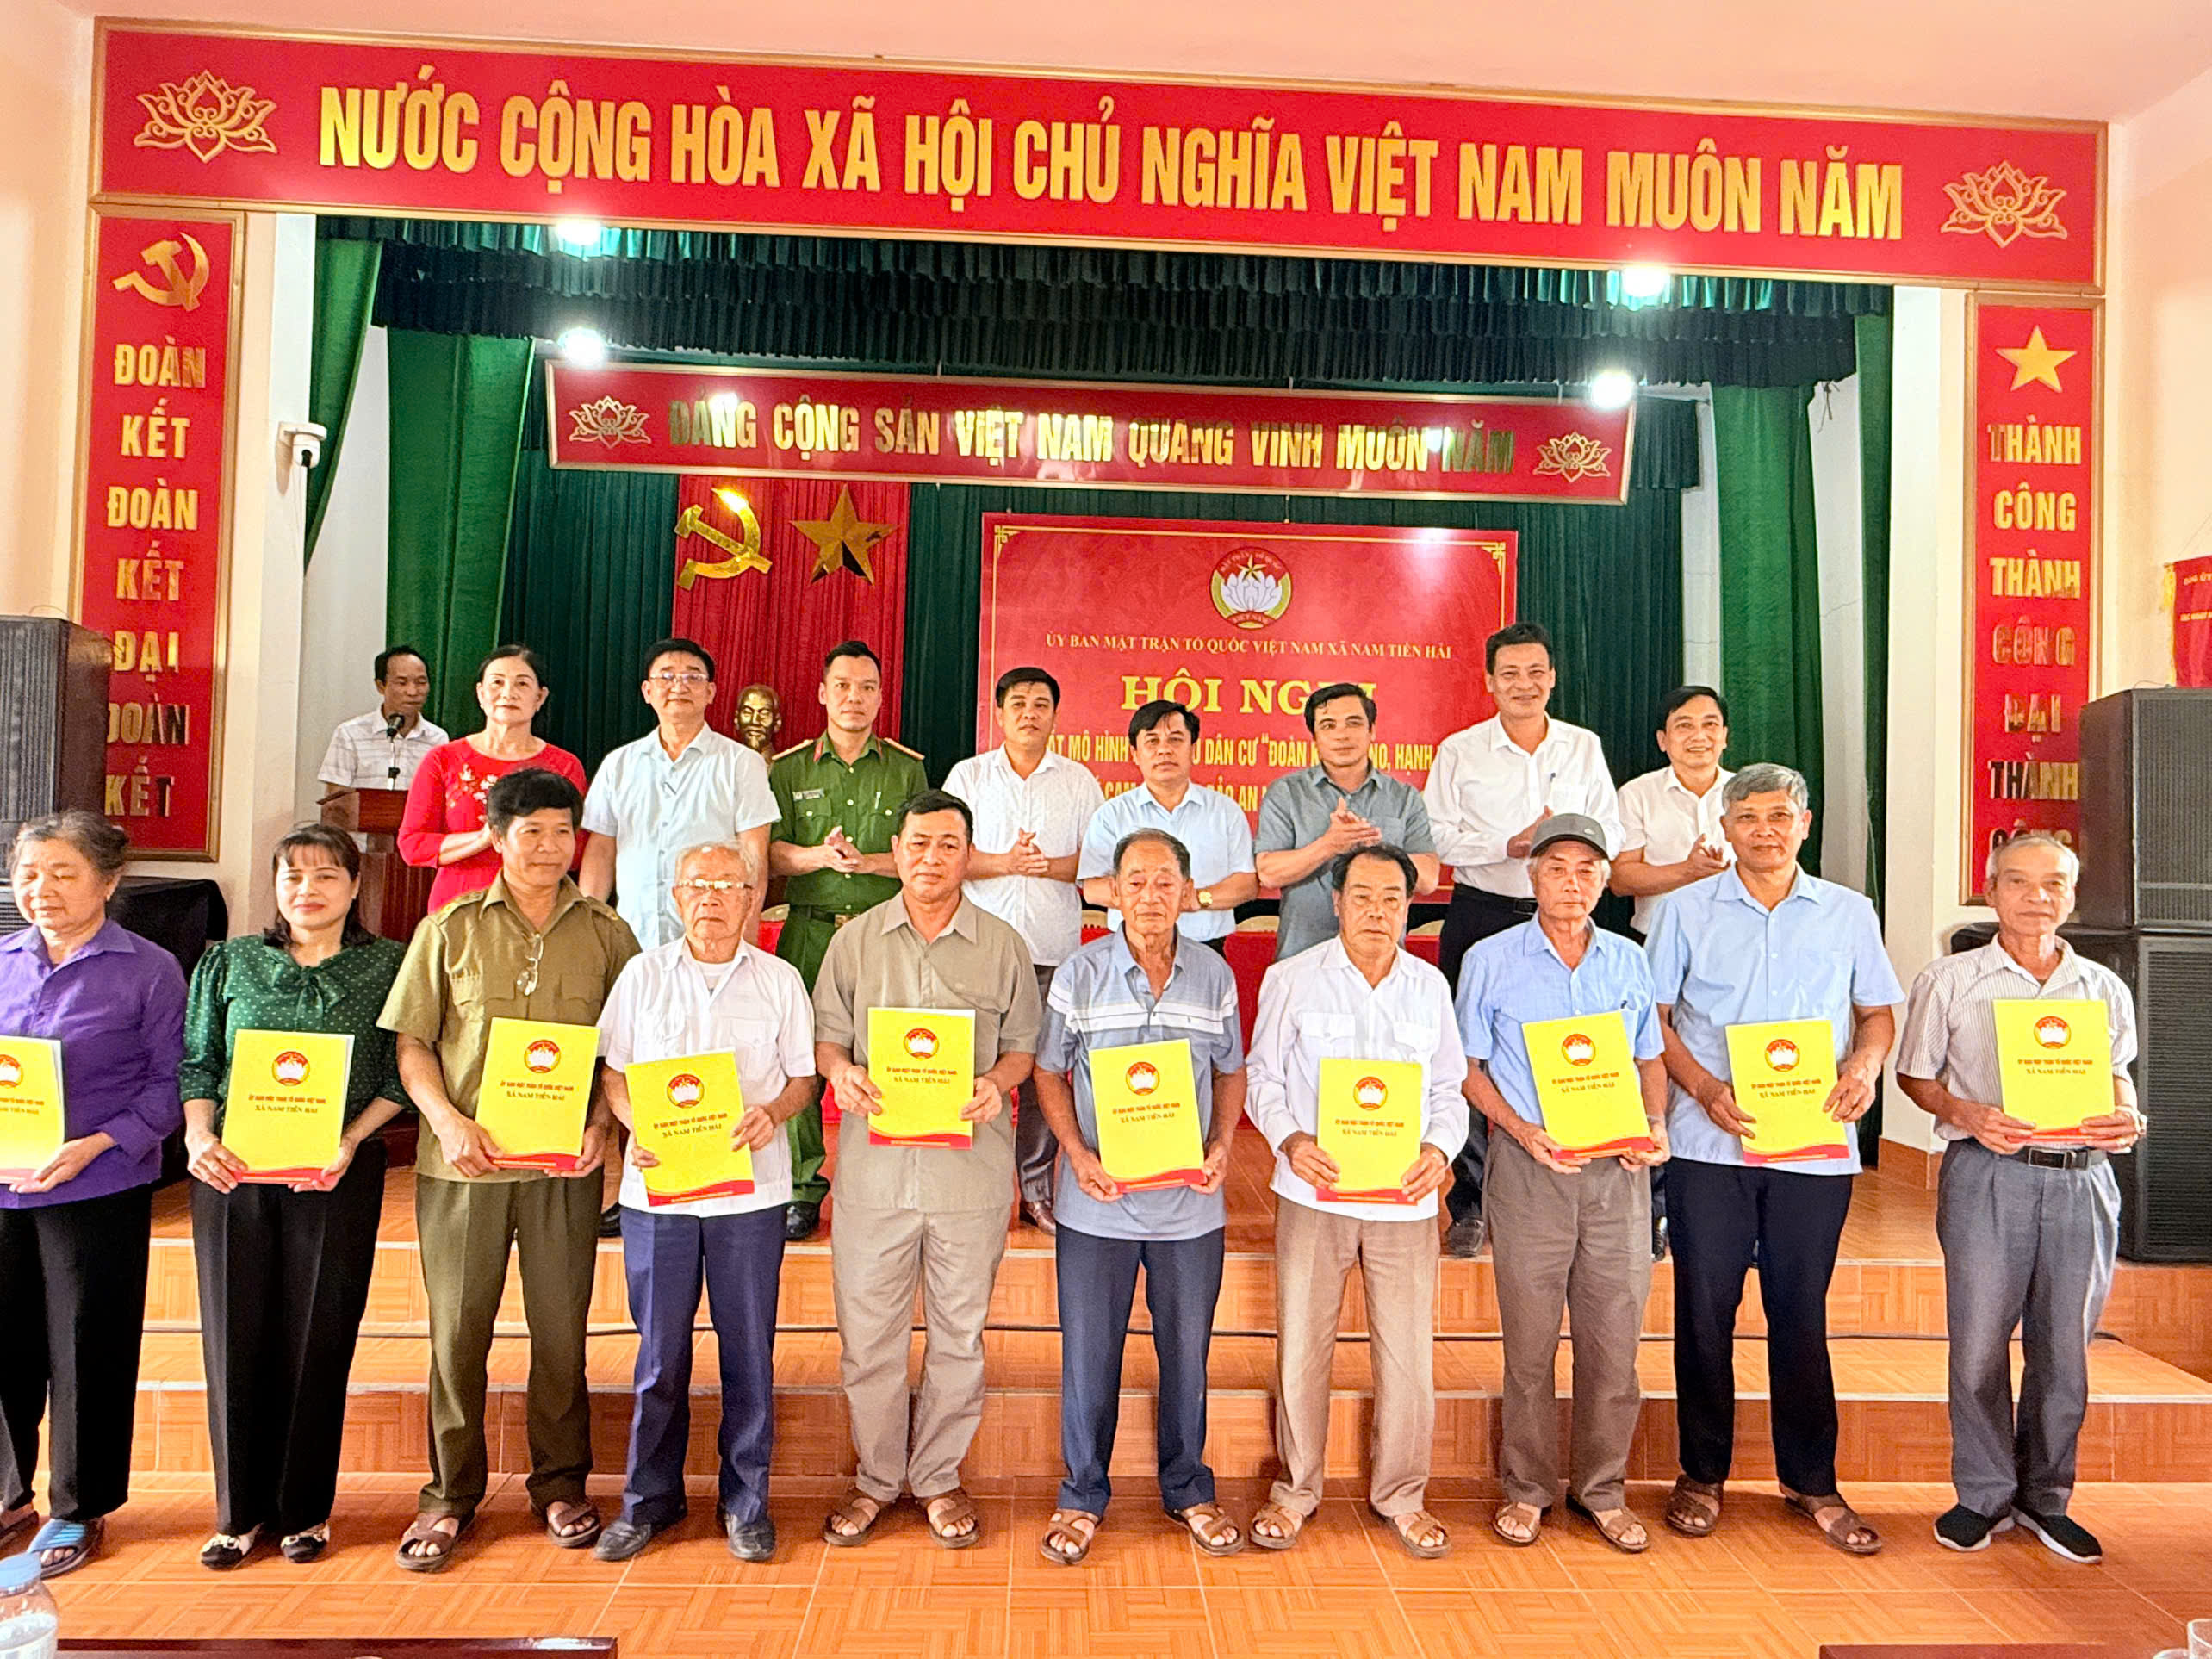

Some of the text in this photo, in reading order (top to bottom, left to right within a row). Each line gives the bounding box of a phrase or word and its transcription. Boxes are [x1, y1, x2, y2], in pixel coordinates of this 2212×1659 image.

[320, 64, 1903, 240] NƯỚC CỘNG HÒA XÃ HỘI CHỦ NGHĨA VIỆT NAM MUÔN NĂM
[114, 334, 206, 388] ĐOÀN
[121, 397, 190, 459] KẾT
[774, 394, 860, 461] CỘNG
[874, 395, 940, 455] SẢN
[954, 406, 1024, 466] VIỆT
[1036, 413, 1114, 462] NAM
[1128, 418, 1234, 468] QUANG
[1251, 422, 1323, 468] VINH
[1336, 416, 1428, 471] MUÔN
[1442, 419, 1515, 473] NĂM
[1987, 414, 2081, 464] THÀNH
[107, 477, 198, 531] ĐOÀN
[1993, 482, 2077, 531] CÔNG
[115, 539, 184, 601] KẾT
[1989, 549, 2081, 599] THÀNH
[113, 630, 179, 682] ĐẠI
[1070, 634, 1099, 649] BAN
[1291, 642, 1324, 656] NAM
[1351, 643, 1384, 657] NAM
[1992, 615, 2075, 666] CÔNG
[1240, 680, 1376, 716] NG
[1069, 730, 1090, 762] MÔ
[1095, 730, 1129, 763] HÌNH
[1205, 733, 1233, 765] DÂN
[1238, 736, 1258, 767] CƯ
[1395, 743, 1433, 776] HẠNH
[1988, 751, 2078, 800] THÀNH
[104, 755, 174, 817] KẾT
